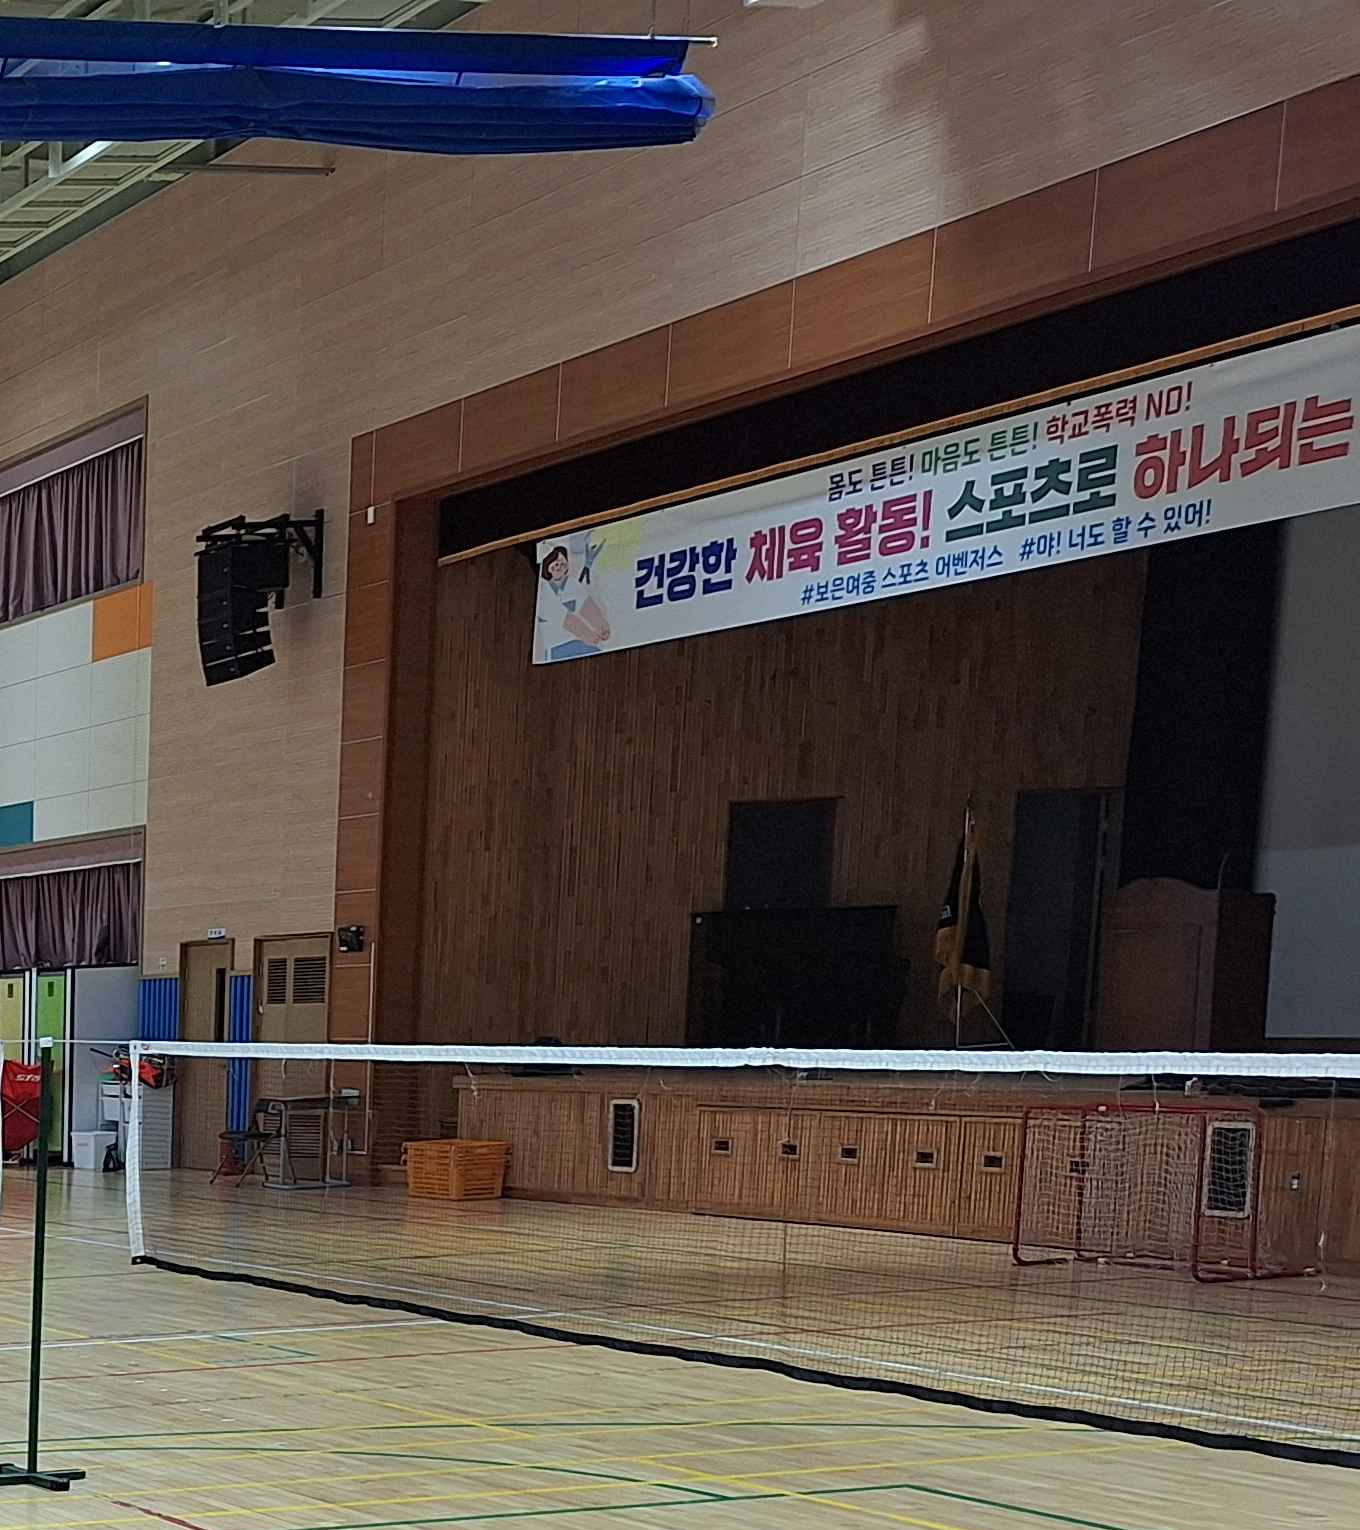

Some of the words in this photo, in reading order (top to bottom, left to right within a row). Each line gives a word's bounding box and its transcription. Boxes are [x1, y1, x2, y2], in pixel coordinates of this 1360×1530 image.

[828, 469, 862, 501] 몸도
[869, 455, 913, 490] 튼튼!
[921, 438, 980, 475] 마음도
[986, 422, 1038, 461] 튼튼!
[1046, 395, 1135, 444] 학교폭력
[1144, 381, 1192, 421] NO!
[635, 537, 735, 609] 건강한
[744, 518, 823, 583] 체육
[836, 490, 932, 565] 활동!
[945, 445, 1117, 542] 스포츠로
[1133, 396, 1353, 499] 하나되는
[800, 571, 875, 605] #보은여중
[880, 560, 929, 590] 스포츠
[935, 548, 1003, 578] 어벤저스
[1019, 537, 1059, 561] #야!
[1068, 522, 1104, 550] 너도
[1111, 516, 1131, 545] 할
[1136, 512, 1156, 538] 수
[1163, 499, 1211, 533] 있어!
